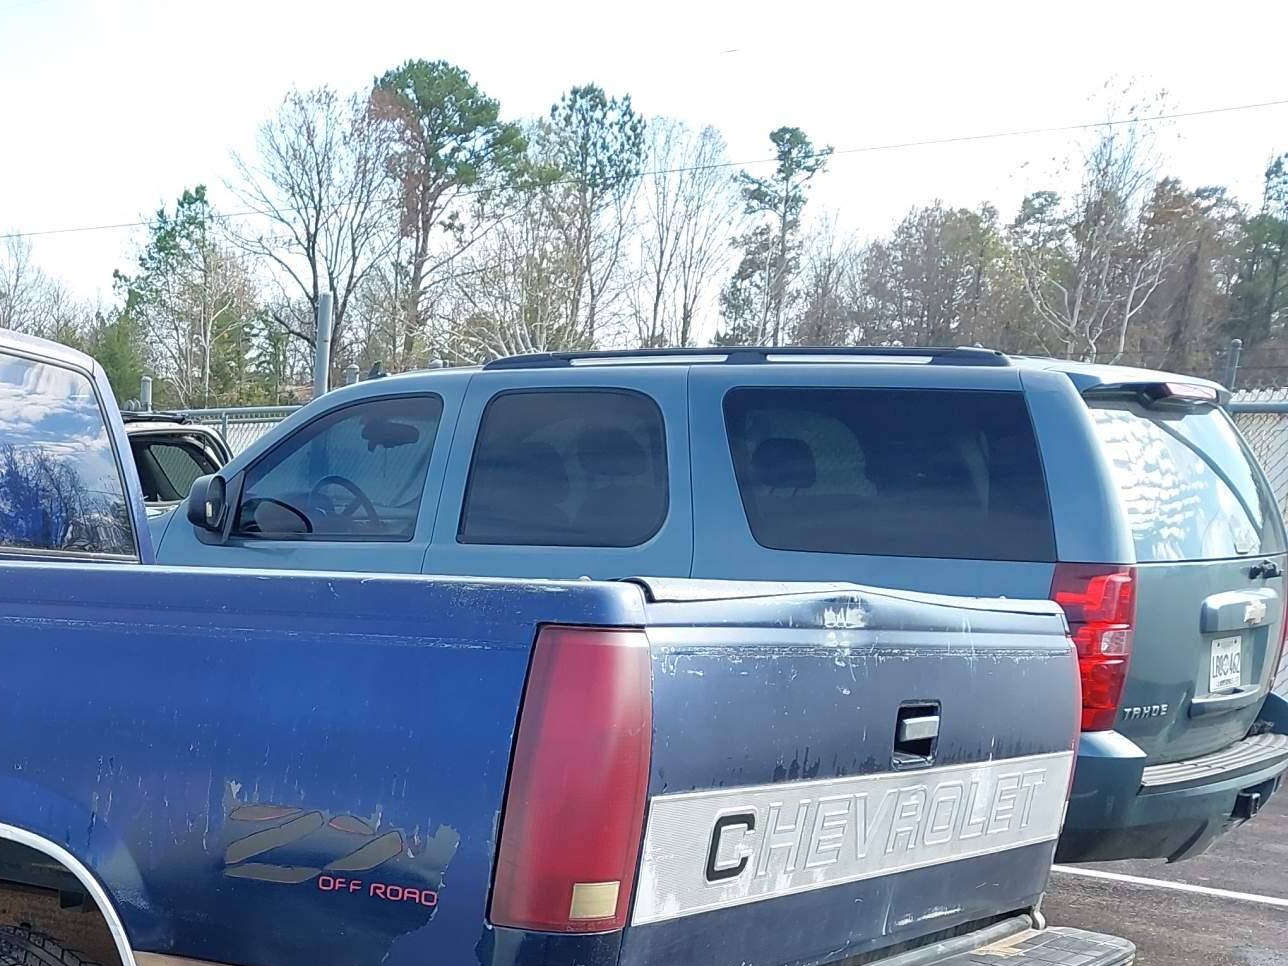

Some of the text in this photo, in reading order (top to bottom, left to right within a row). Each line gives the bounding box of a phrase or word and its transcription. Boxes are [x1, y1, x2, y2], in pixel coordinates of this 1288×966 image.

[1123, 703, 1169, 720] TAHOE
[704, 768, 1047, 886] CHEVROLET
[318, 875, 438, 907] OFF ROAD
